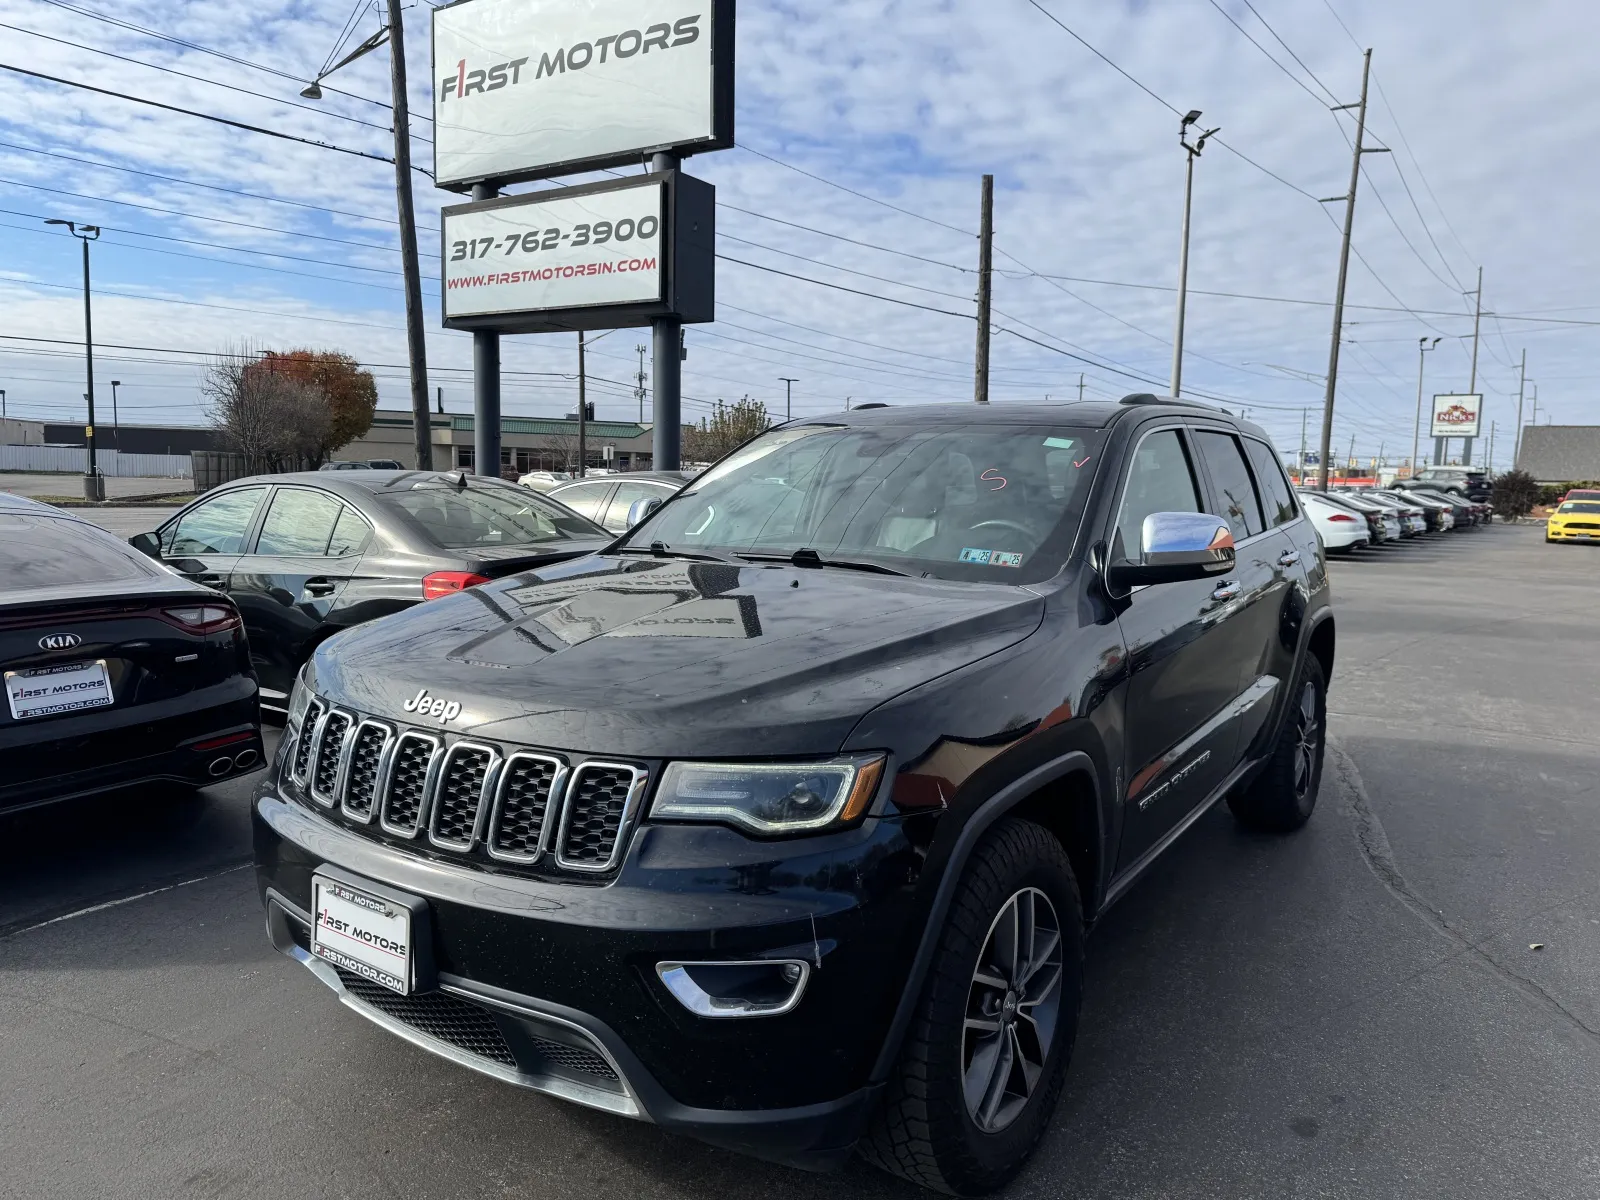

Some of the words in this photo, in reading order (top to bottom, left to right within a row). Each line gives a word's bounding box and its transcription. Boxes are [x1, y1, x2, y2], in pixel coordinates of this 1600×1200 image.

[535, 14, 702, 80] MOTORS
[450, 215, 659, 262] 317-762-3900
[448, 257, 657, 290] WWW.FIRSTMOTORSIN.COM
[980, 468, 1007, 491] S
[46, 635, 76, 648] KIA
[52, 664, 82, 673] MOTORS
[52, 679, 105, 694] MOTORS
[403, 689, 462, 725] Jeep
[354, 894, 385, 913] MOTORS
[352, 926, 405, 955] MOTORS
